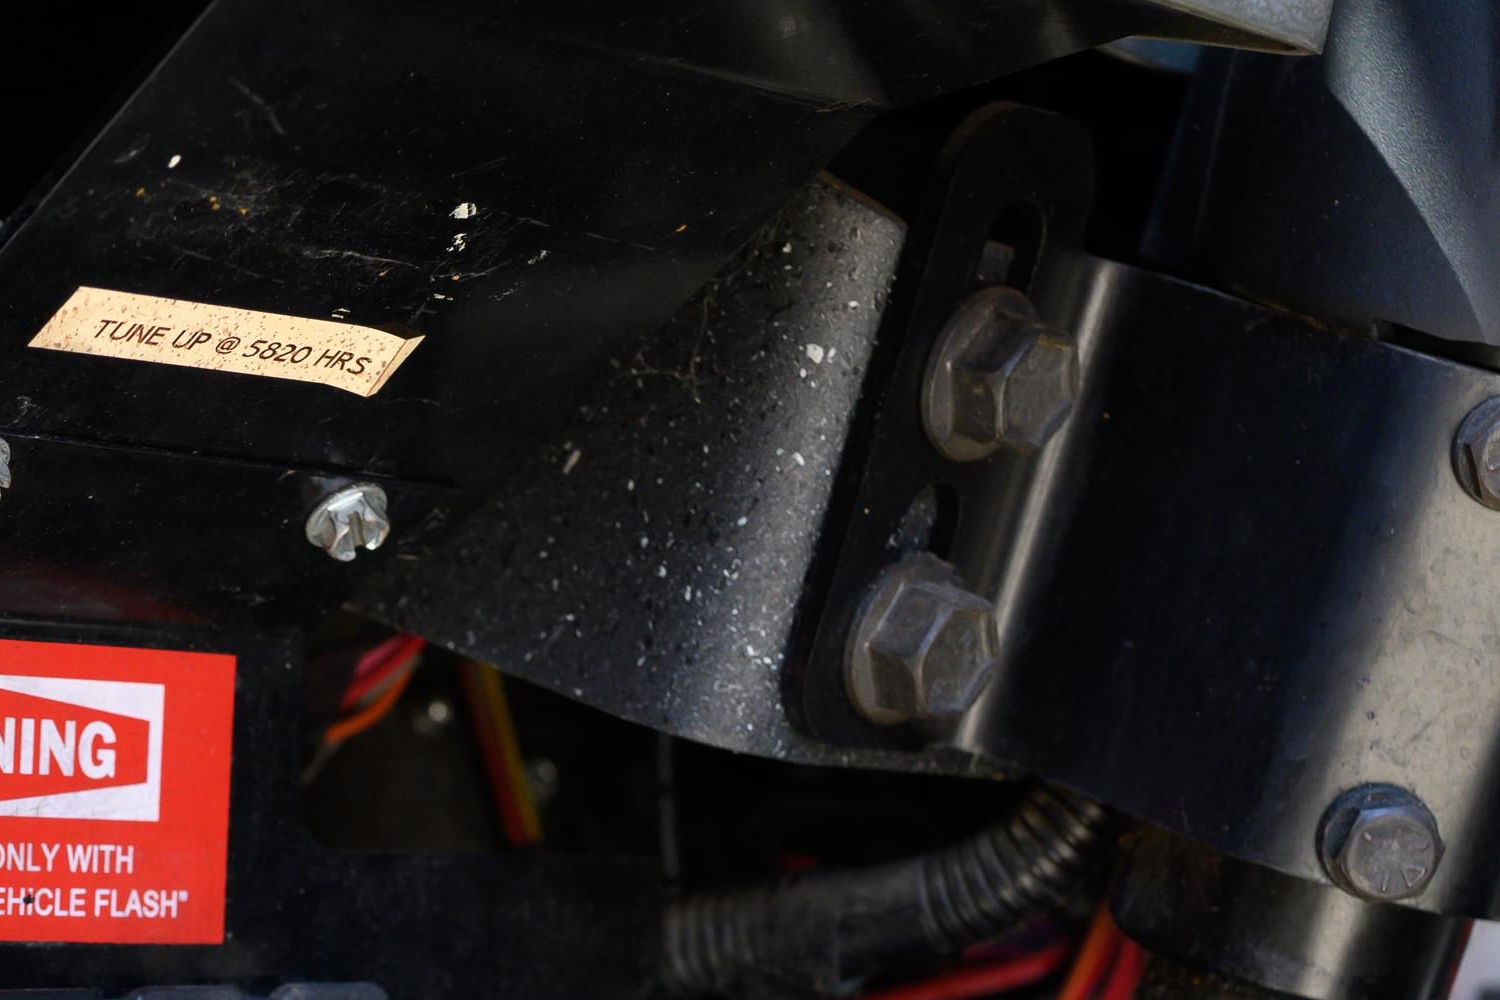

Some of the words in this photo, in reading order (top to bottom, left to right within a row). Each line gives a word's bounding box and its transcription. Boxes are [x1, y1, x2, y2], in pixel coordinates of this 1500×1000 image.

[94, 319, 171, 346] TUNE
[172, 327, 212, 350] UP
[215, 336, 241, 354] @
[242, 339, 312, 364] 5820
[313, 348, 372, 376] HRS
[66, 844, 134, 874] WITH
[94, 888, 189, 919] FLASH"
